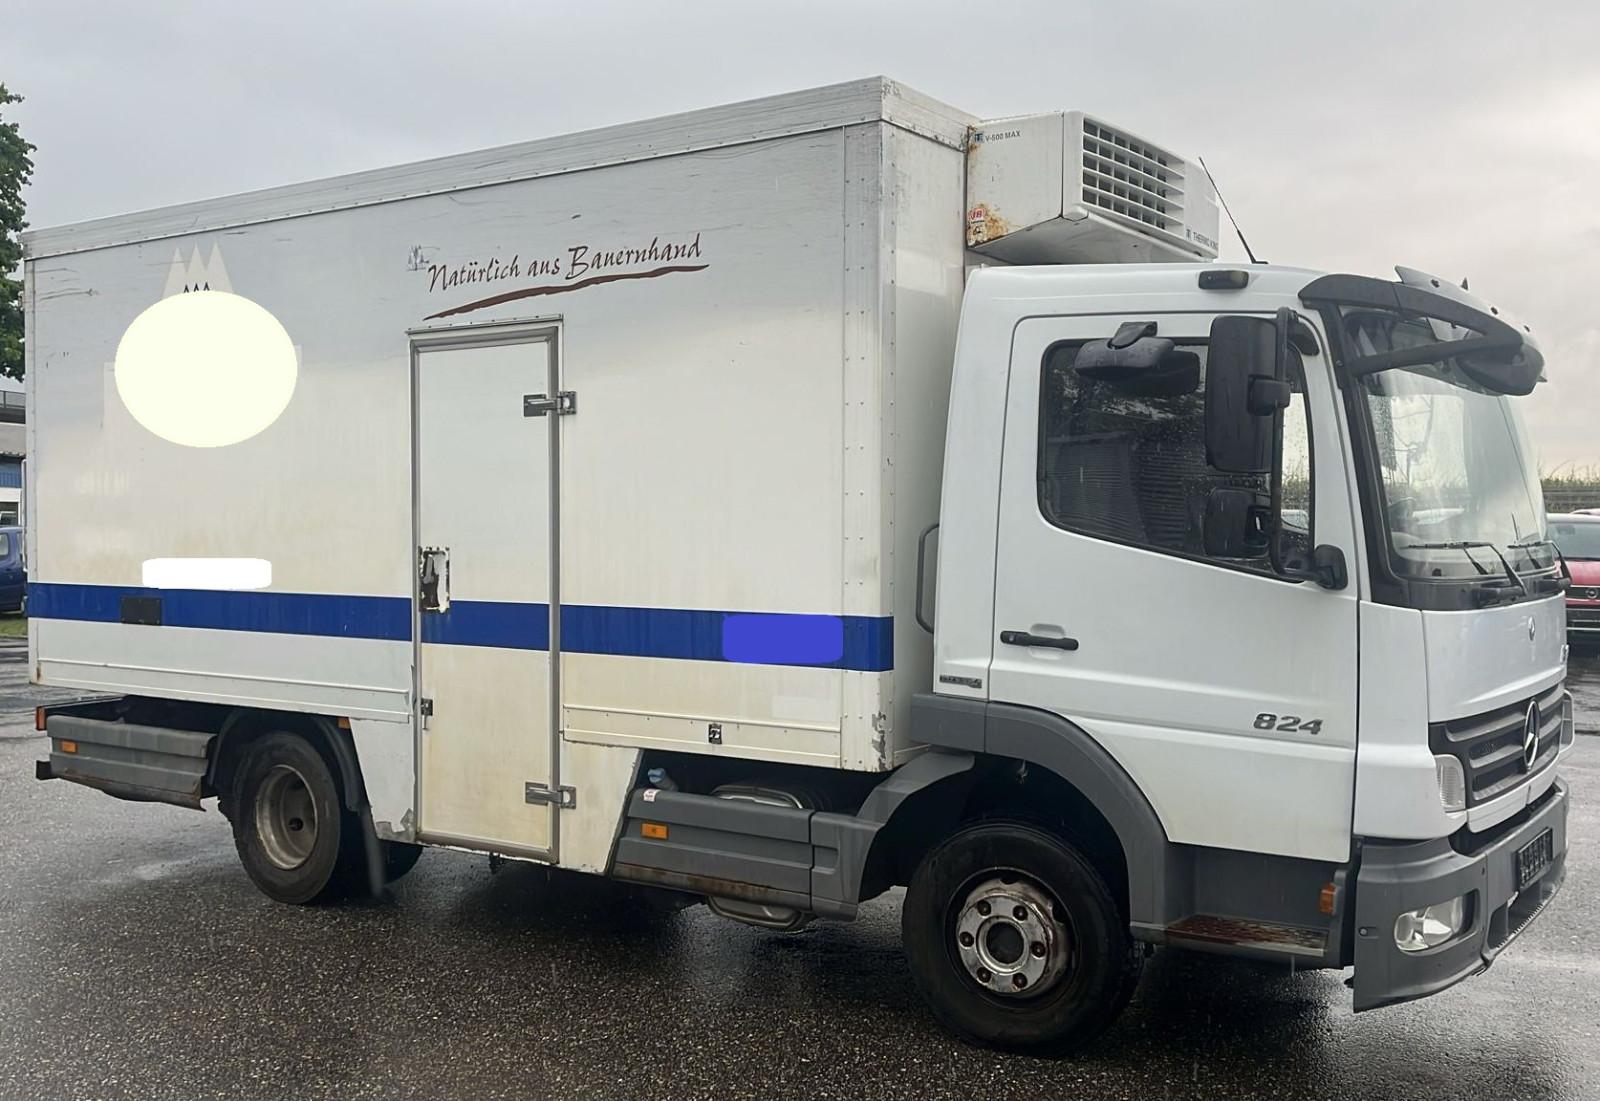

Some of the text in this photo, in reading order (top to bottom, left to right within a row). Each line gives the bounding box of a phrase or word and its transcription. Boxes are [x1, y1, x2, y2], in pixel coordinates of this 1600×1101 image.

[1004, 130, 1021, 139] MAX
[427, 232, 703, 293] Natürlich aus Bauernhand
[1253, 713, 1323, 735] 824
